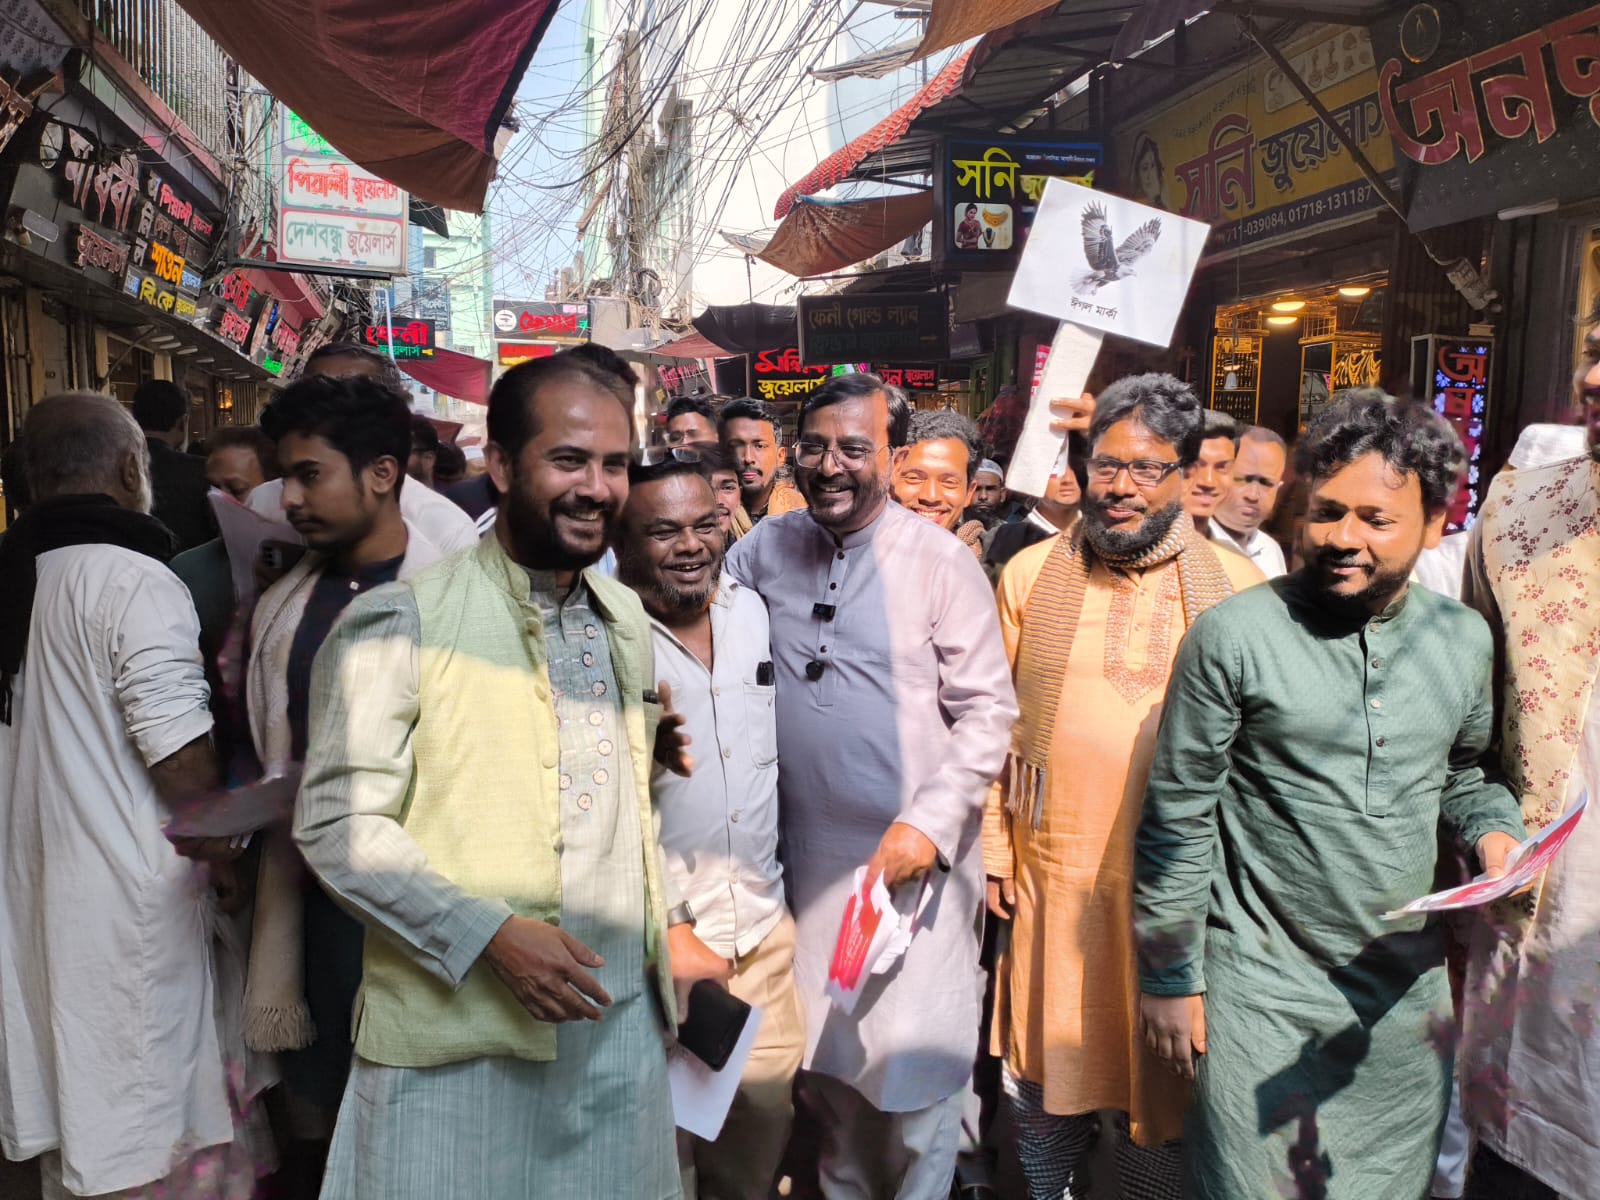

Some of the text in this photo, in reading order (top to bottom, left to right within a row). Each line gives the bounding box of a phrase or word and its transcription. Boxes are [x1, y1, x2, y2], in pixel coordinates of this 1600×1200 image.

[952, 147, 1021, 199] সনি
[285, 219, 397, 257] দেশবন্ধু জুয়েলার্স
